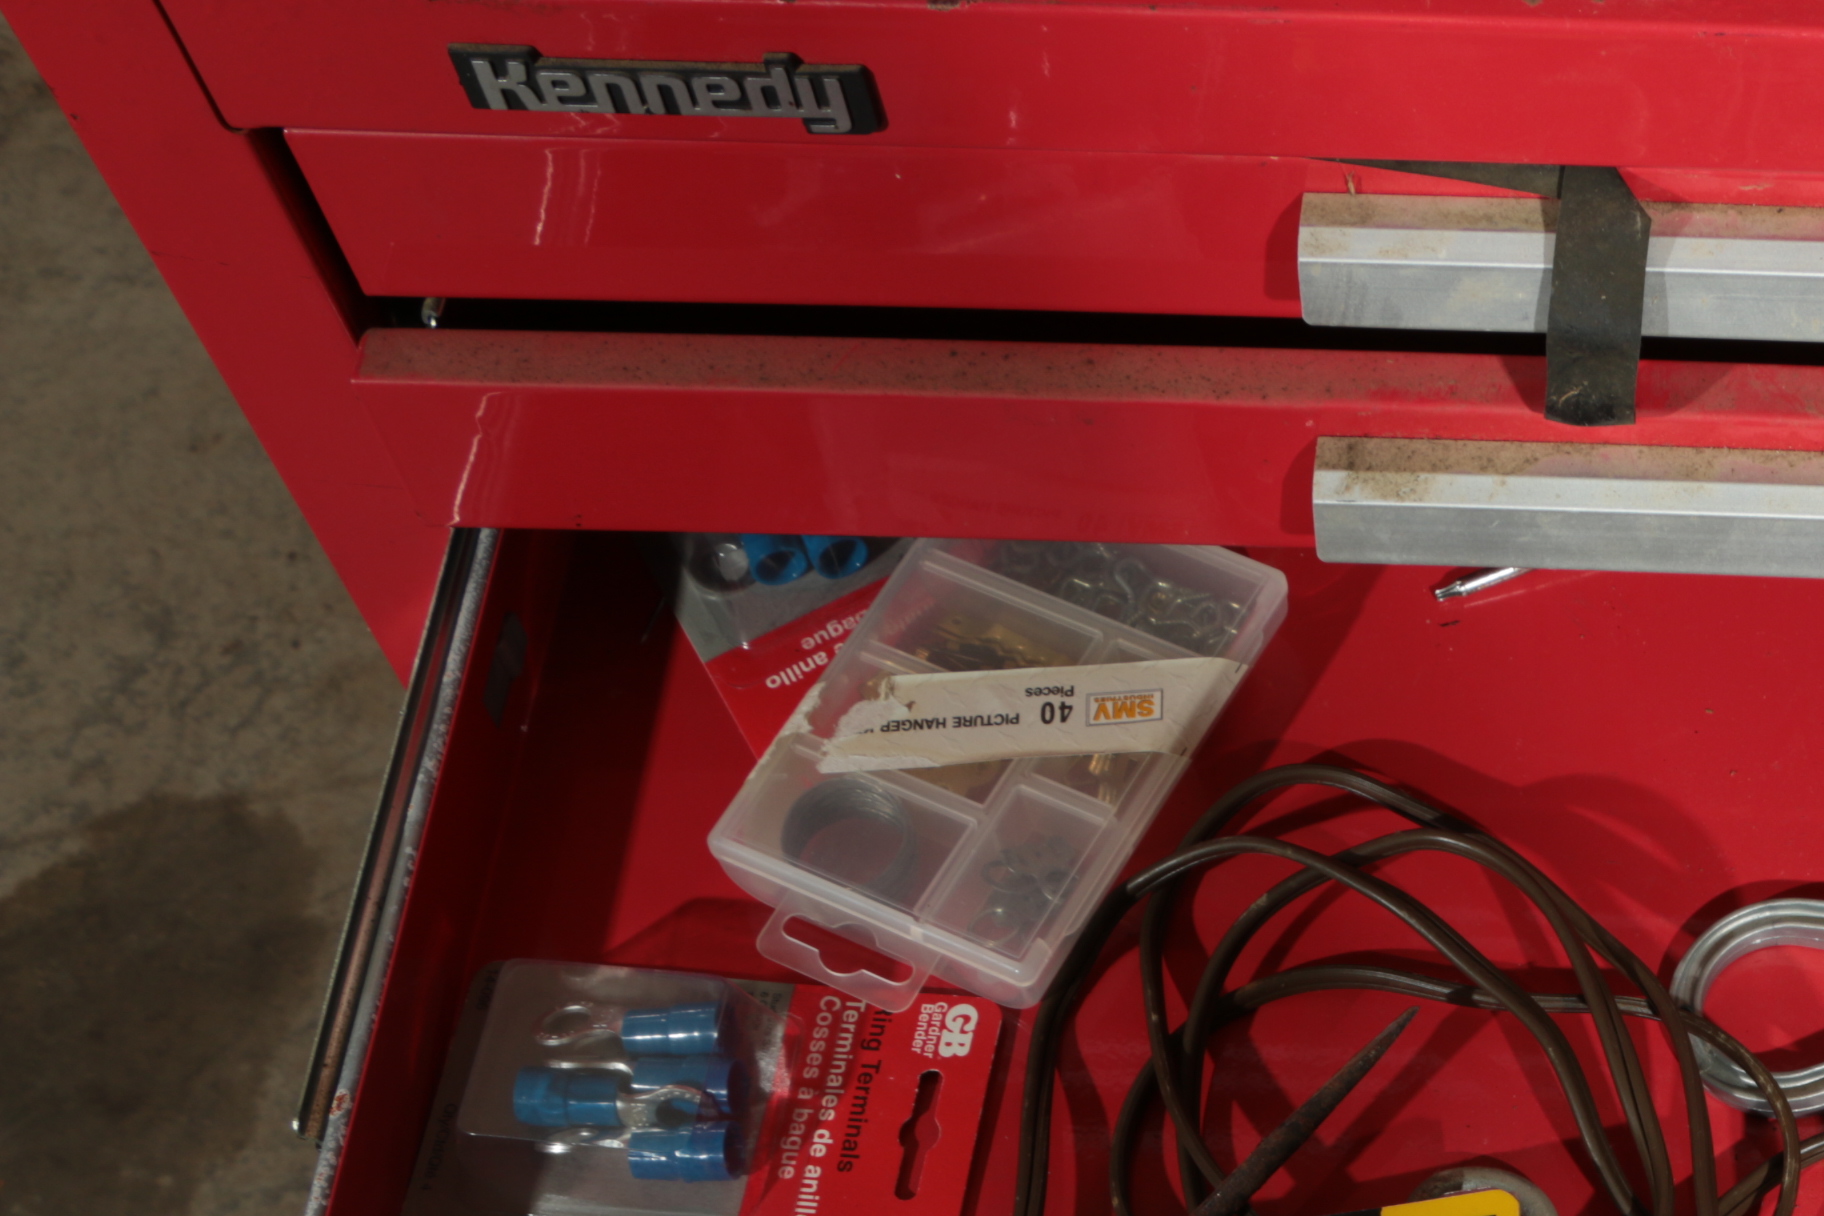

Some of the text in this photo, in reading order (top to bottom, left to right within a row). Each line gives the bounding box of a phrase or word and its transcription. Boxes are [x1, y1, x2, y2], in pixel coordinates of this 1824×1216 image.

[469, 58, 852, 134] Kennedy
[951, 711, 1021, 728] PICTURE
[1025, 684, 1076, 699] Pieces
[1040, 700, 1075, 725] 40
[1092, 699, 1156, 722] SMV
[802, 994, 842, 1082] Cosses
[911, 1002, 934, 1056] Bender
[920, 1001, 949, 1060] Gardner
[938, 1002, 979, 1059] GB
[817, 999, 868, 1125] Terminales
[777, 1106, 813, 1182] bague
[810, 1128, 834, 1159] de
[836, 1059, 883, 1175] Terminals
